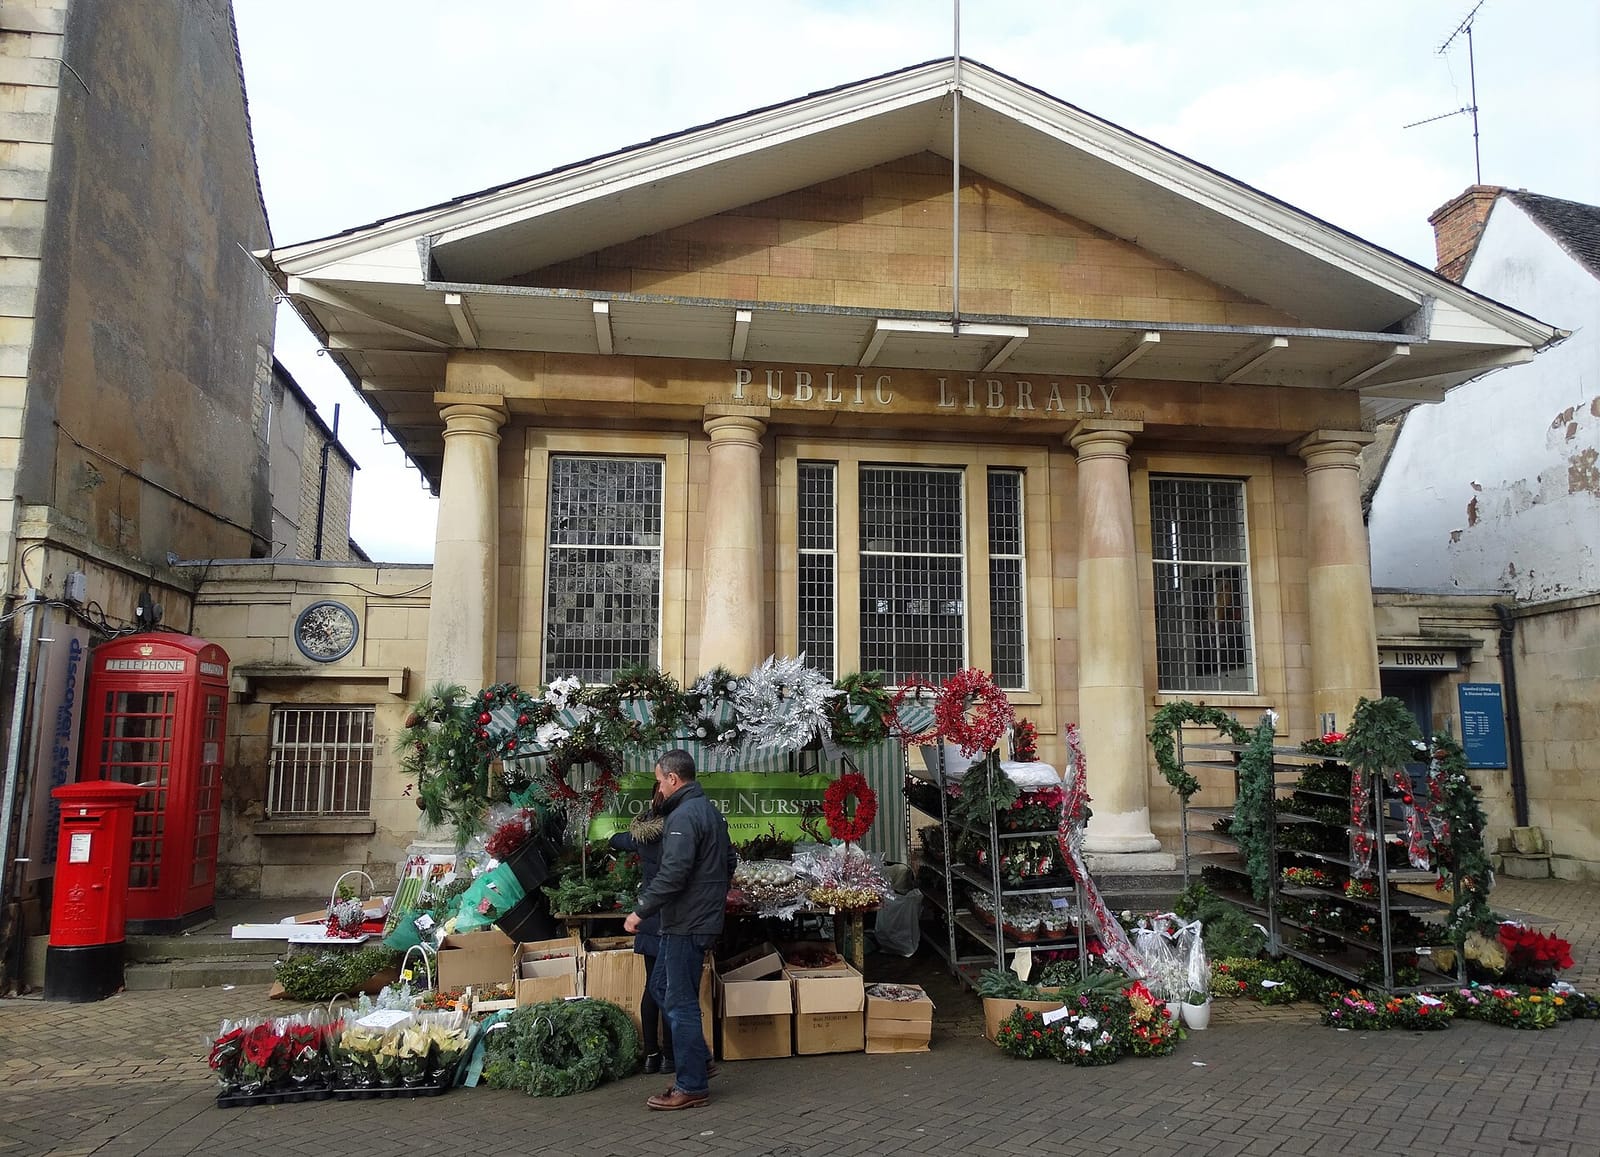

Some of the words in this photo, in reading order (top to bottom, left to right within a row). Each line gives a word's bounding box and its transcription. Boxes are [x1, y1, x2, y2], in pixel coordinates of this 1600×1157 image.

[732, 368, 893, 405] PUBLIC
[937, 377, 1118, 414] LIBRARY
[110, 660, 182, 670] TELEPHONE
[1395, 652, 1445, 665] LIBRARY
[63, 638, 83, 742] discover
